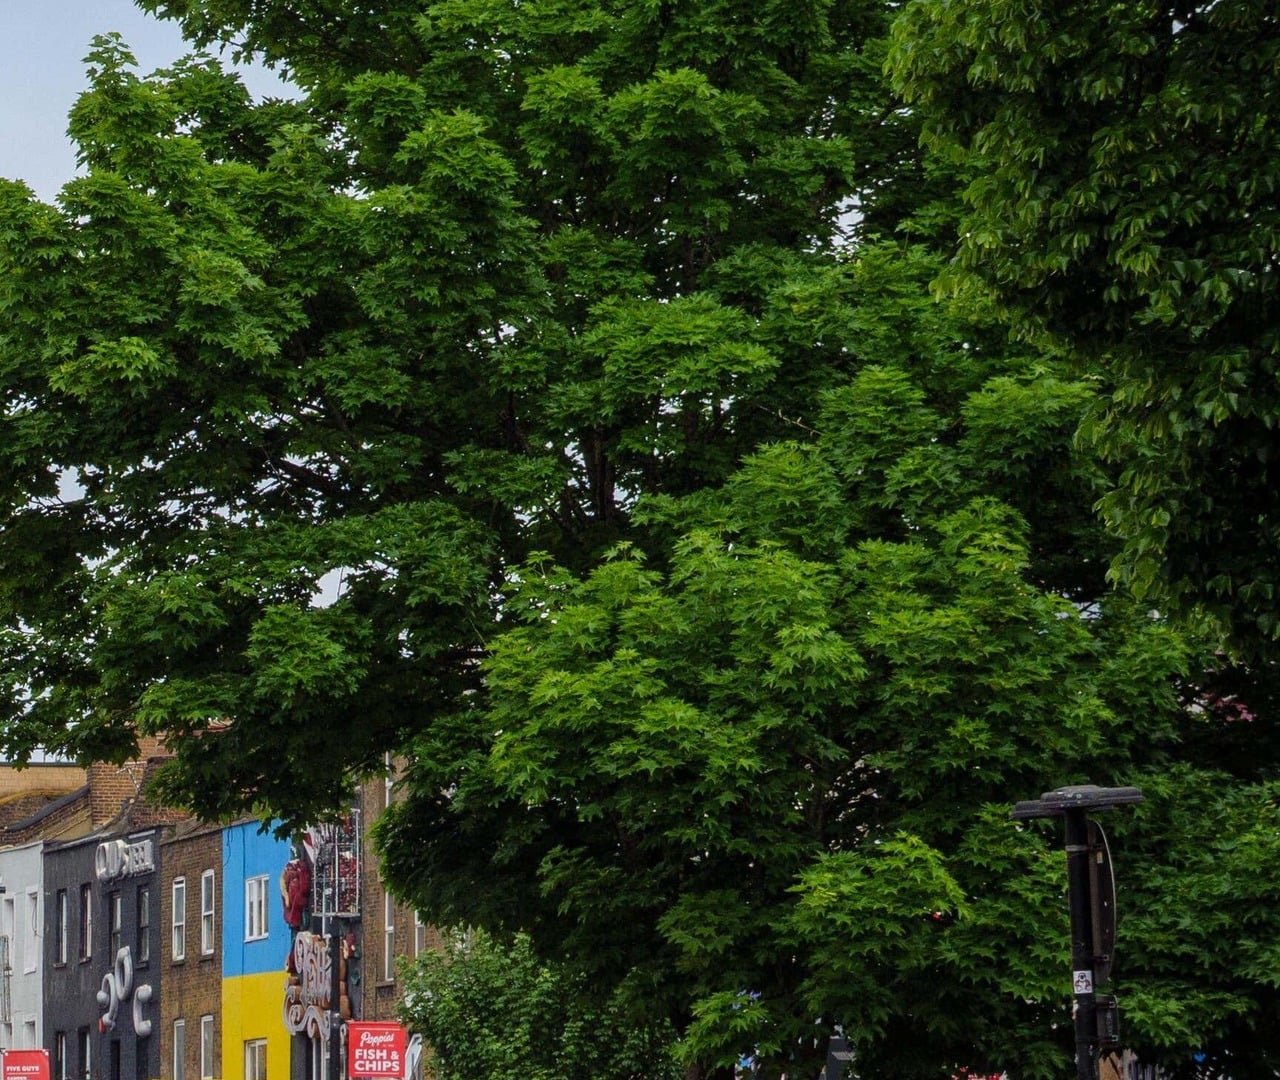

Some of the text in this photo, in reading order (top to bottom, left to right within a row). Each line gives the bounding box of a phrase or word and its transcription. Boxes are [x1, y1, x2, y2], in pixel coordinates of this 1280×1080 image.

[360, 1031, 394, 1047] Poppies
[355, 1049, 399, 1060] FISH &
[354, 1060, 400, 1072] CHIPS
